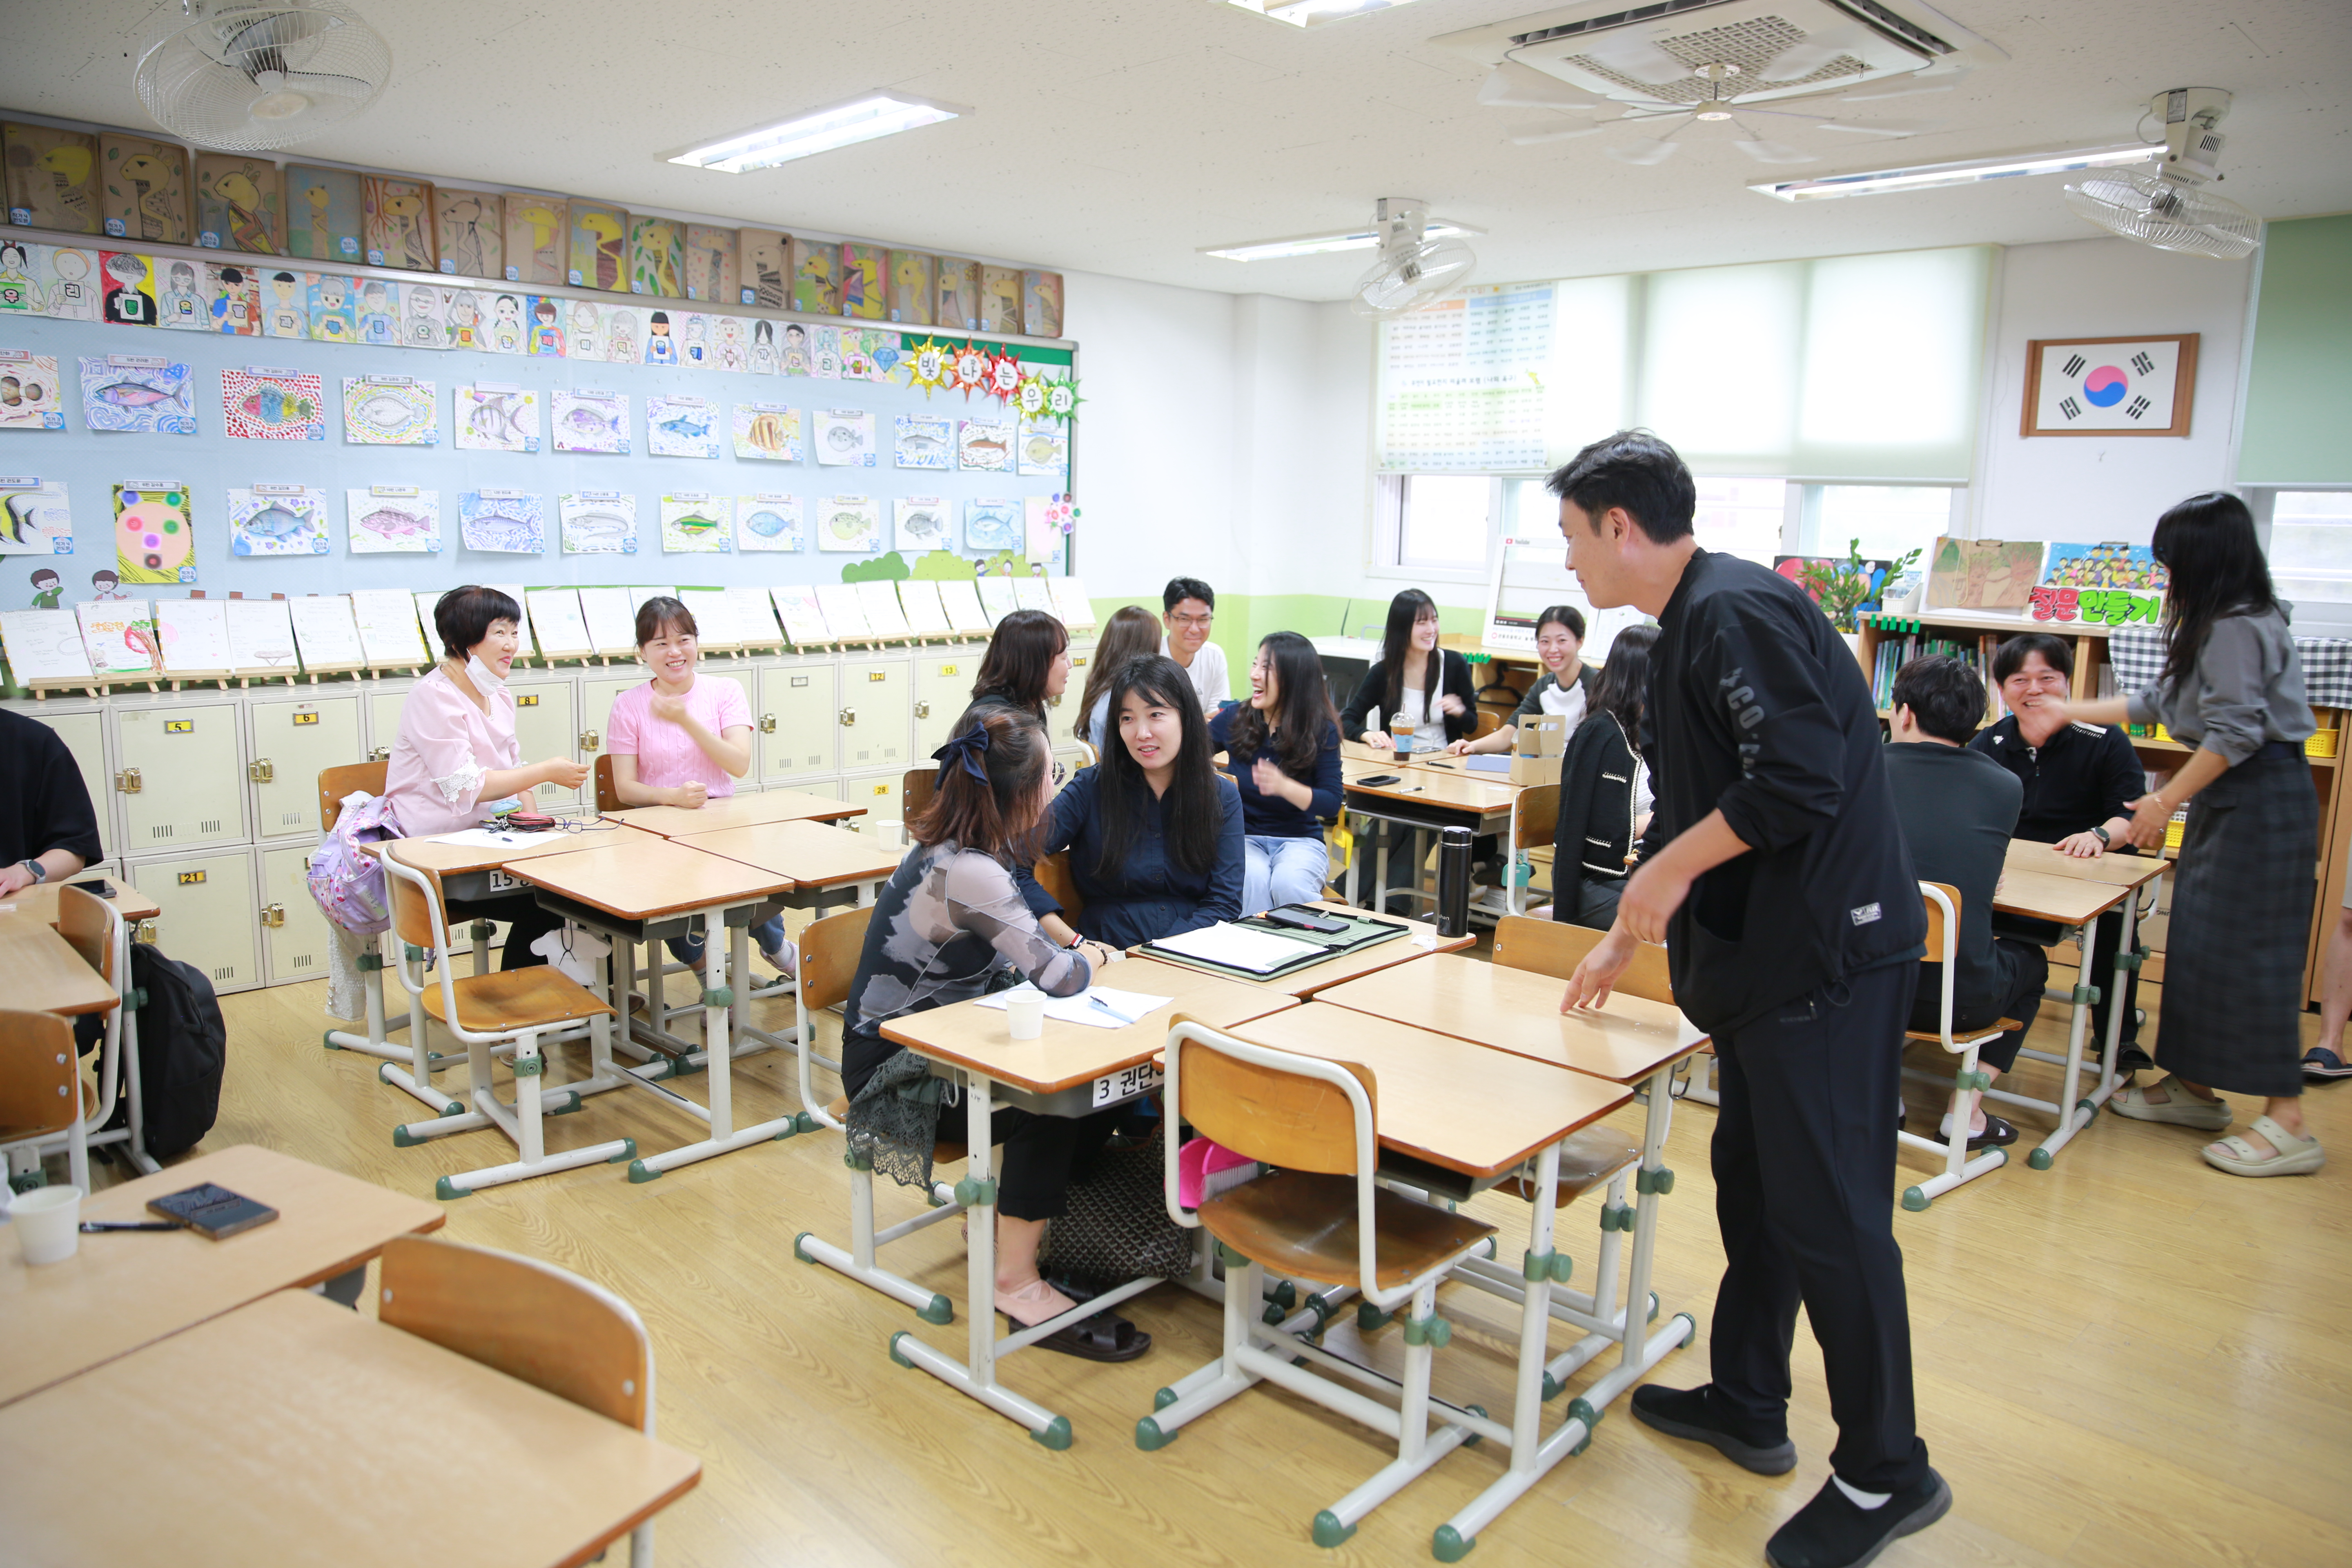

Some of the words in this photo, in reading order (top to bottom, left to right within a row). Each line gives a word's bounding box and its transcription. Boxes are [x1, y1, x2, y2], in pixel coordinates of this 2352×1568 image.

[4, 289, 19, 304] 우
[65, 284, 80, 298] 리
[525, 697, 530, 705] 8
[184, 873, 197, 883] 21
[492, 873, 513, 888] 15
[1100, 1079, 1110, 1099] 3
